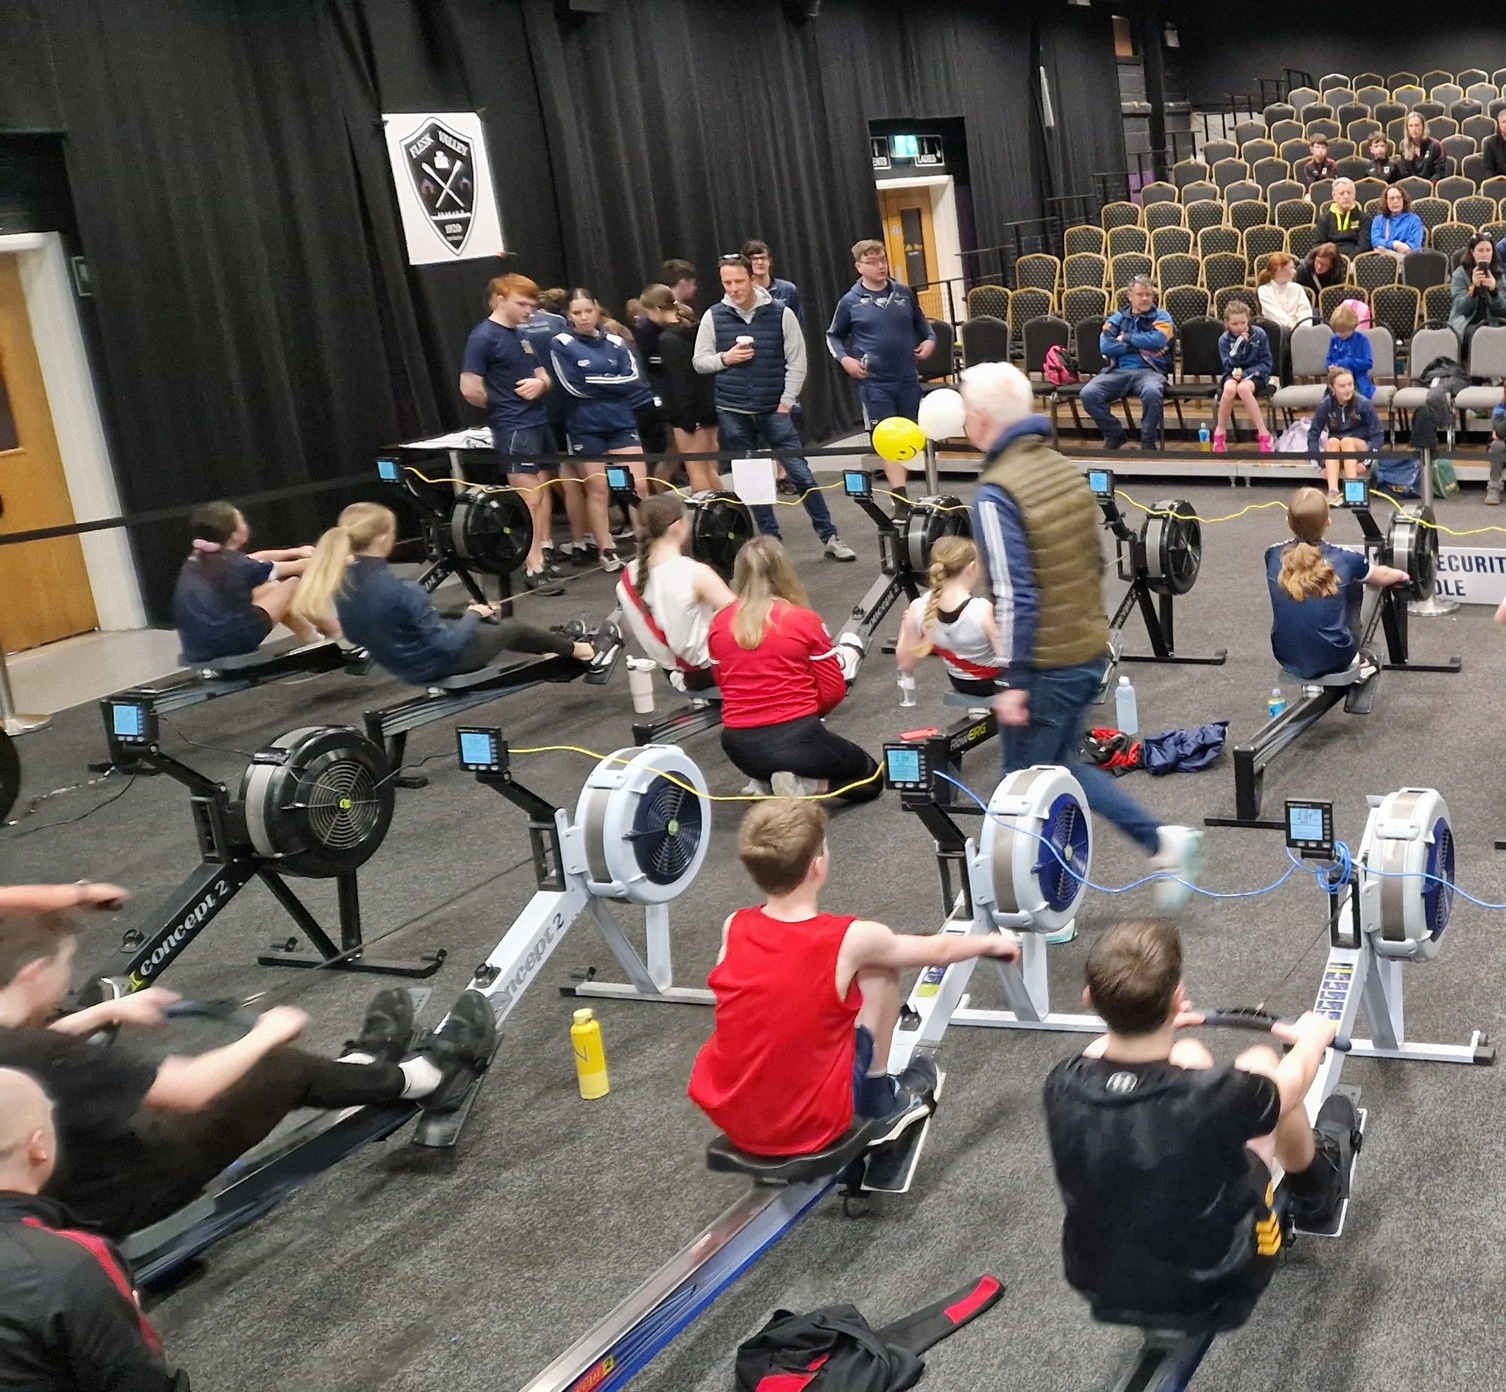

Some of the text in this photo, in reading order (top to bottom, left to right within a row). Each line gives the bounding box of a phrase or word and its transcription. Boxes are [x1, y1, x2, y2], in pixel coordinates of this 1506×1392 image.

[437, 130, 468, 157] VALLEY
[1435, 579, 1466, 596] OLE
[139, 879, 230, 977] concept 2
[502, 912, 566, 999] ncept 2
